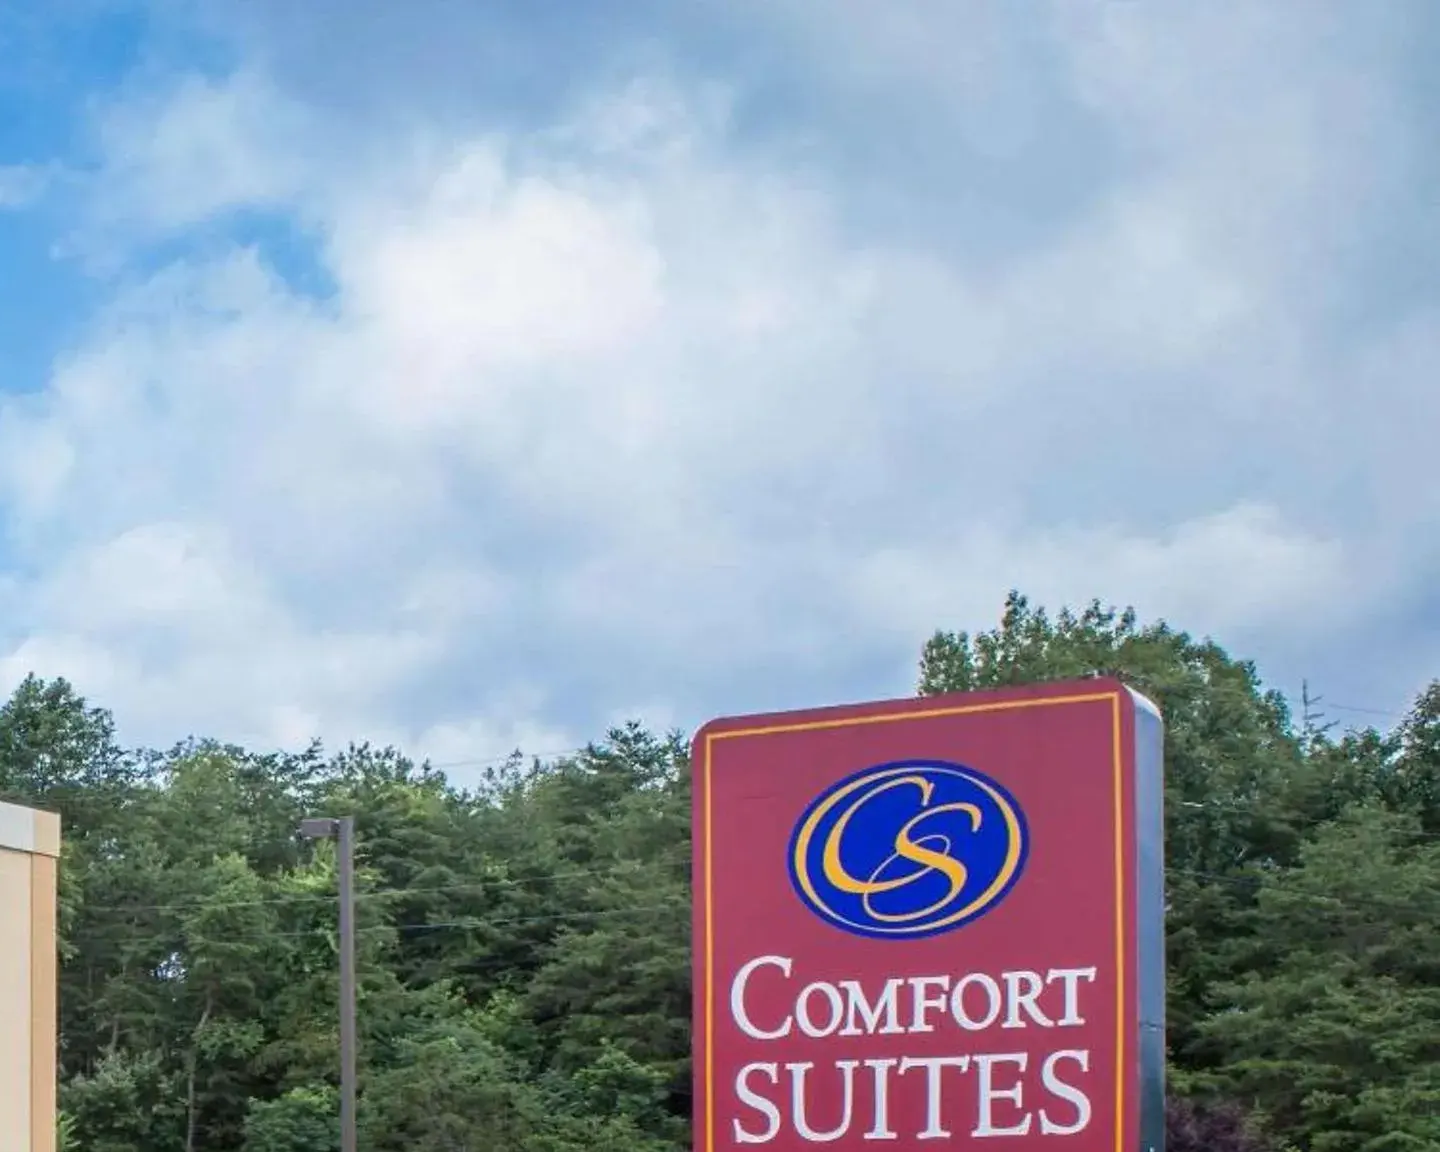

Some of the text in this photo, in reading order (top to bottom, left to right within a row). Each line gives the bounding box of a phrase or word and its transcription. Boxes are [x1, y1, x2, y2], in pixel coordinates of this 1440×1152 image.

[823, 775, 982, 922] CS
[730, 955, 1097, 1040] COMFORT
[732, 1049, 1092, 1144] SUITES
